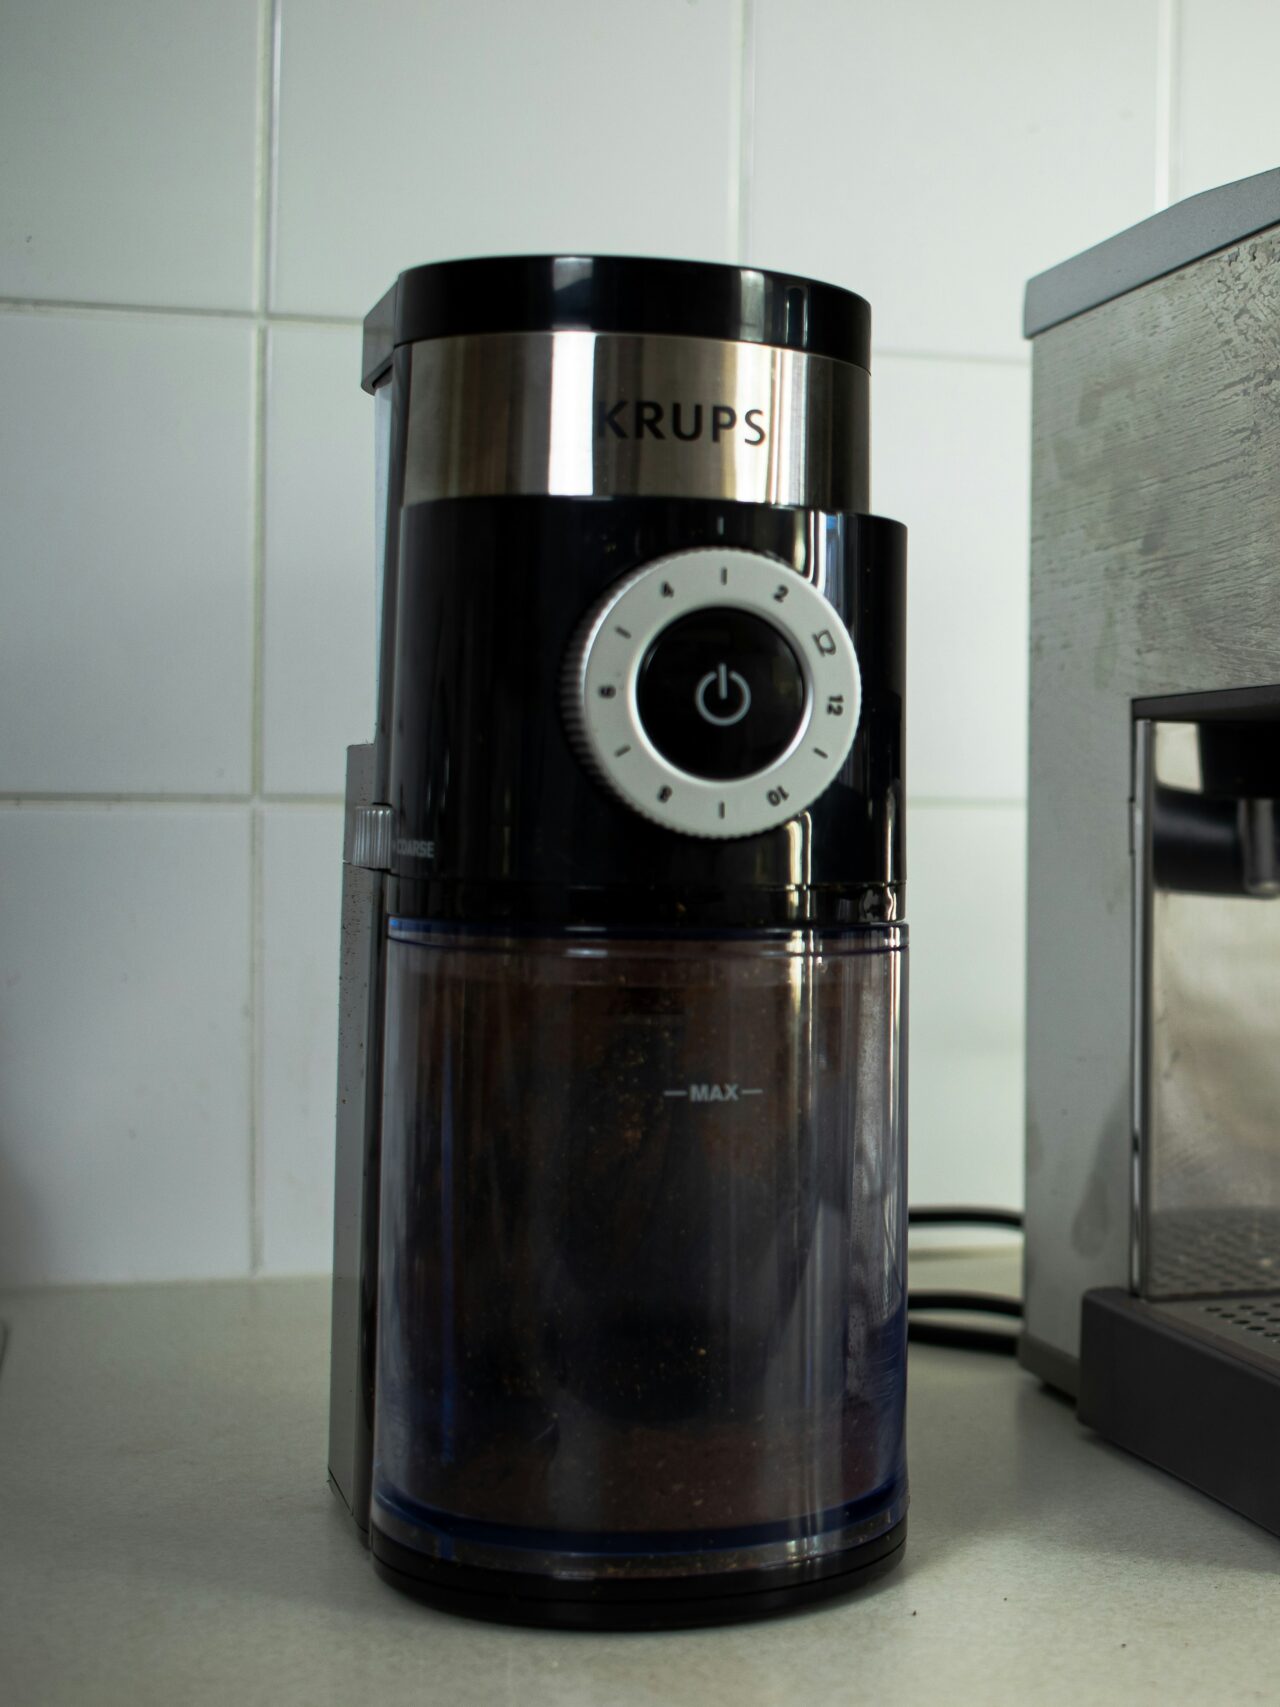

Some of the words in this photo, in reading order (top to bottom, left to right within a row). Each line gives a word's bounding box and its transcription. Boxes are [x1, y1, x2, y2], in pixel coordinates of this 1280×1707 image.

[599, 401, 767, 446] KRUPS
[773, 584, 789, 603] 2
[826, 694, 844, 717] 12
[766, 786, 790, 807] 10
[690, 1083, 739, 1101] MAX
